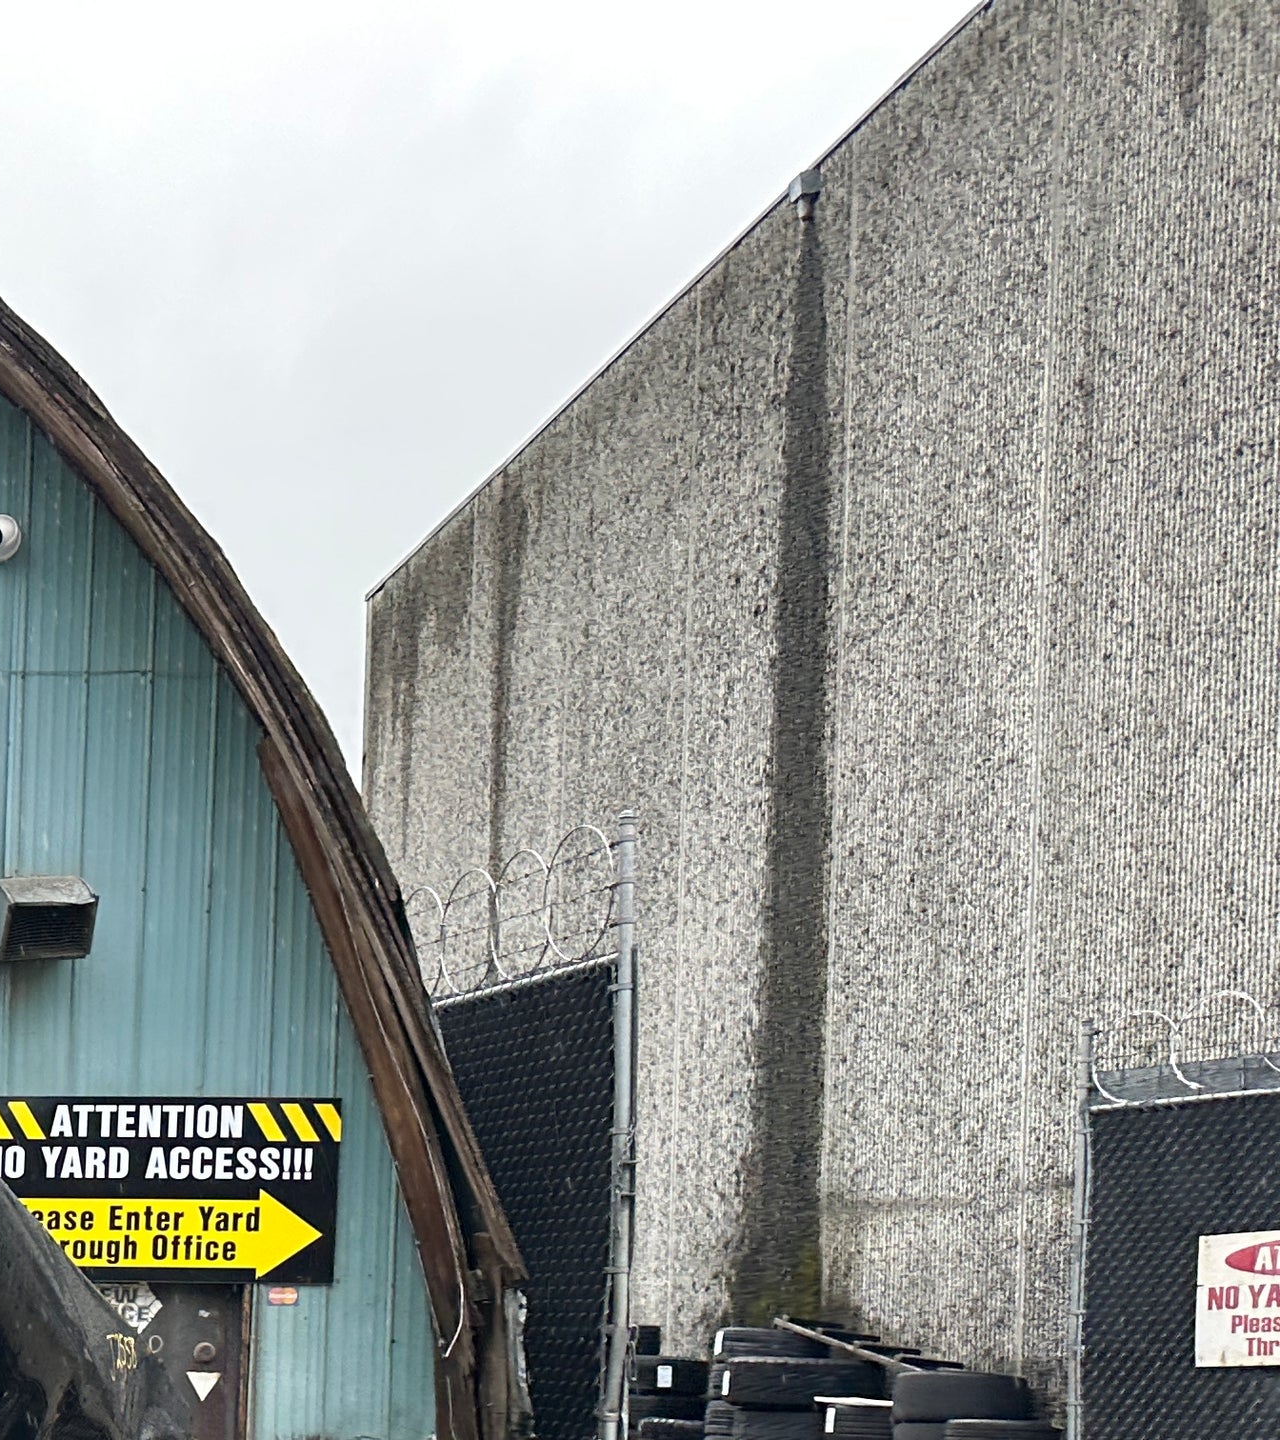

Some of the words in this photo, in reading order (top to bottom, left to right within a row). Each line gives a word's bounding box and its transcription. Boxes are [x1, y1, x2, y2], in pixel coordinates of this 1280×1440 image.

[50, 1104, 244, 1139] ATTENTION
[41, 1146, 130, 1179] YARD
[144, 1147, 314, 1181] ACCESS!!!
[109, 1206, 185, 1232] Enter
[199, 1206, 261, 1233] Yard
[151, 1236, 237, 1261] Office
[1207, 1285, 1240, 1311] NO
